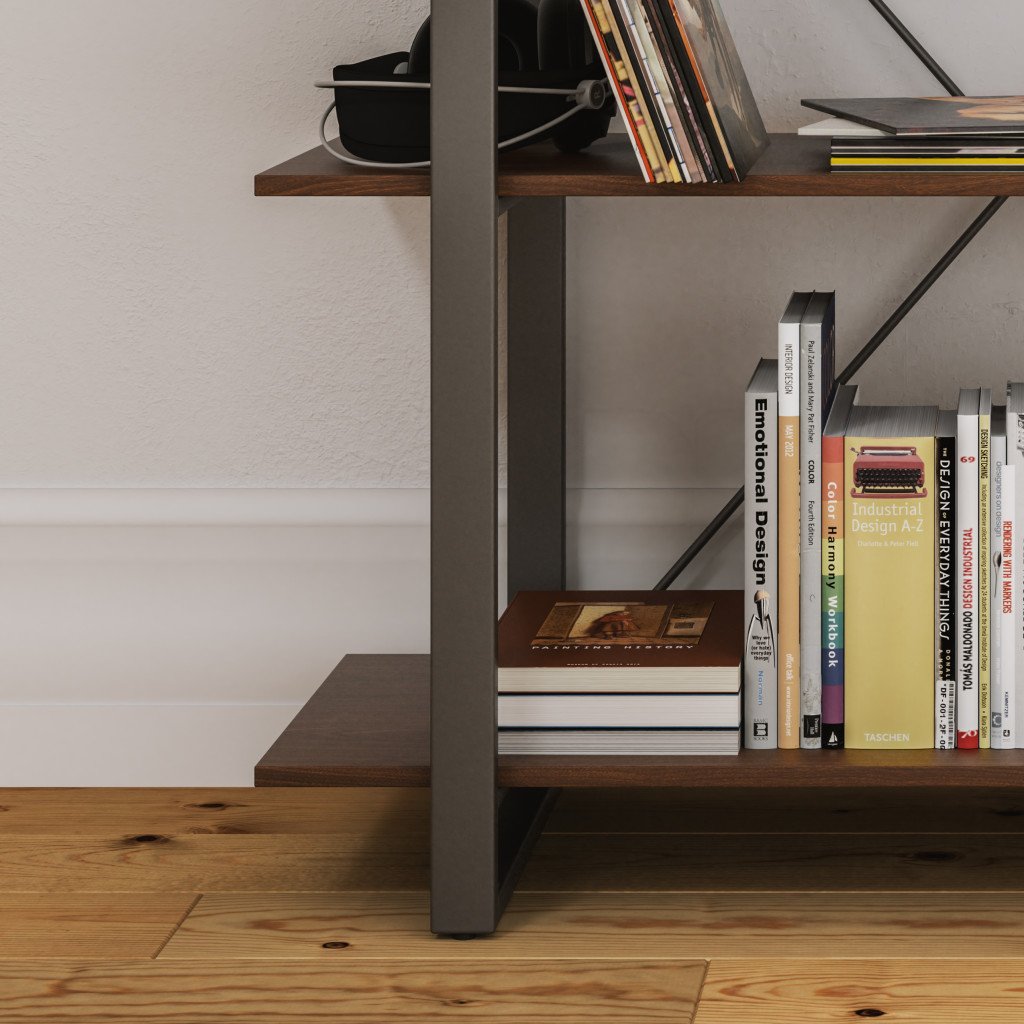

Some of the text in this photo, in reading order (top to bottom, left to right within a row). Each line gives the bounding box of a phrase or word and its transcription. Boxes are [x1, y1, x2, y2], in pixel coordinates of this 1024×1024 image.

[785, 344, 793, 394] INTERIOR DESIGN
[806, 396, 814, 412] Mary
[785, 425, 793, 457] MAY 2012
[752, 398, 768, 585] Emotional Design
[852, 502, 922, 516] Industrial
[940, 460, 950, 510] DESIGN
[996, 501, 1001, 510] on
[852, 519, 924, 535] Design A-Z
[826, 482, 838, 668] Color Harmony Workbook
[940, 521, 950, 588] EVERYDAY
[1003, 521, 1012, 614] RENDERING WITH MARKERS
[940, 591, 950, 640] THINGS
[960, 528, 973, 690] TOMÁS MALDONADO DESIGN INDUSTRIAL
[864, 734, 909, 742] TASCHEN
